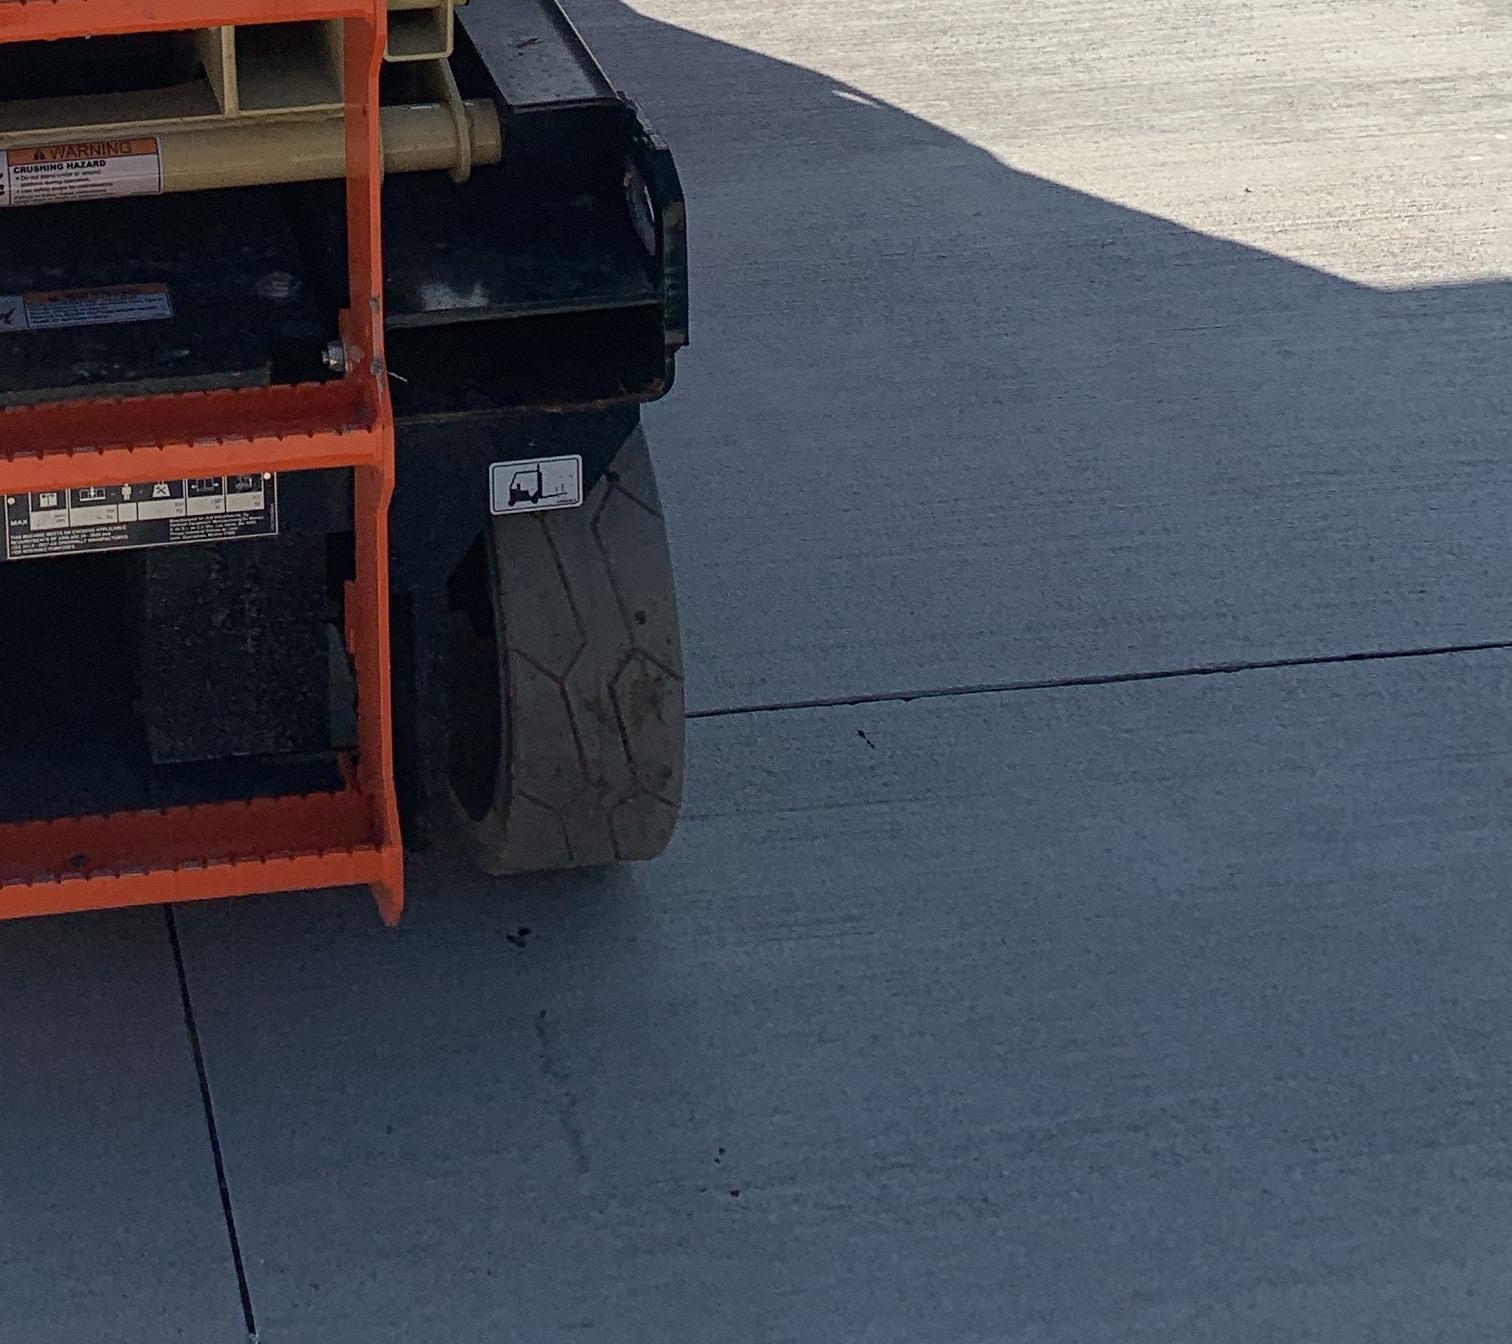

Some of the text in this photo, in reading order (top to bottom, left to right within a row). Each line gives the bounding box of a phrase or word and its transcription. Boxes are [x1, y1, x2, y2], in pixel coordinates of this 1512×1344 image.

[51, 140, 132, 160] WARNING
[13, 159, 107, 174] CRUSHING HAZARD
[10, 519, 28, 527] MAX
